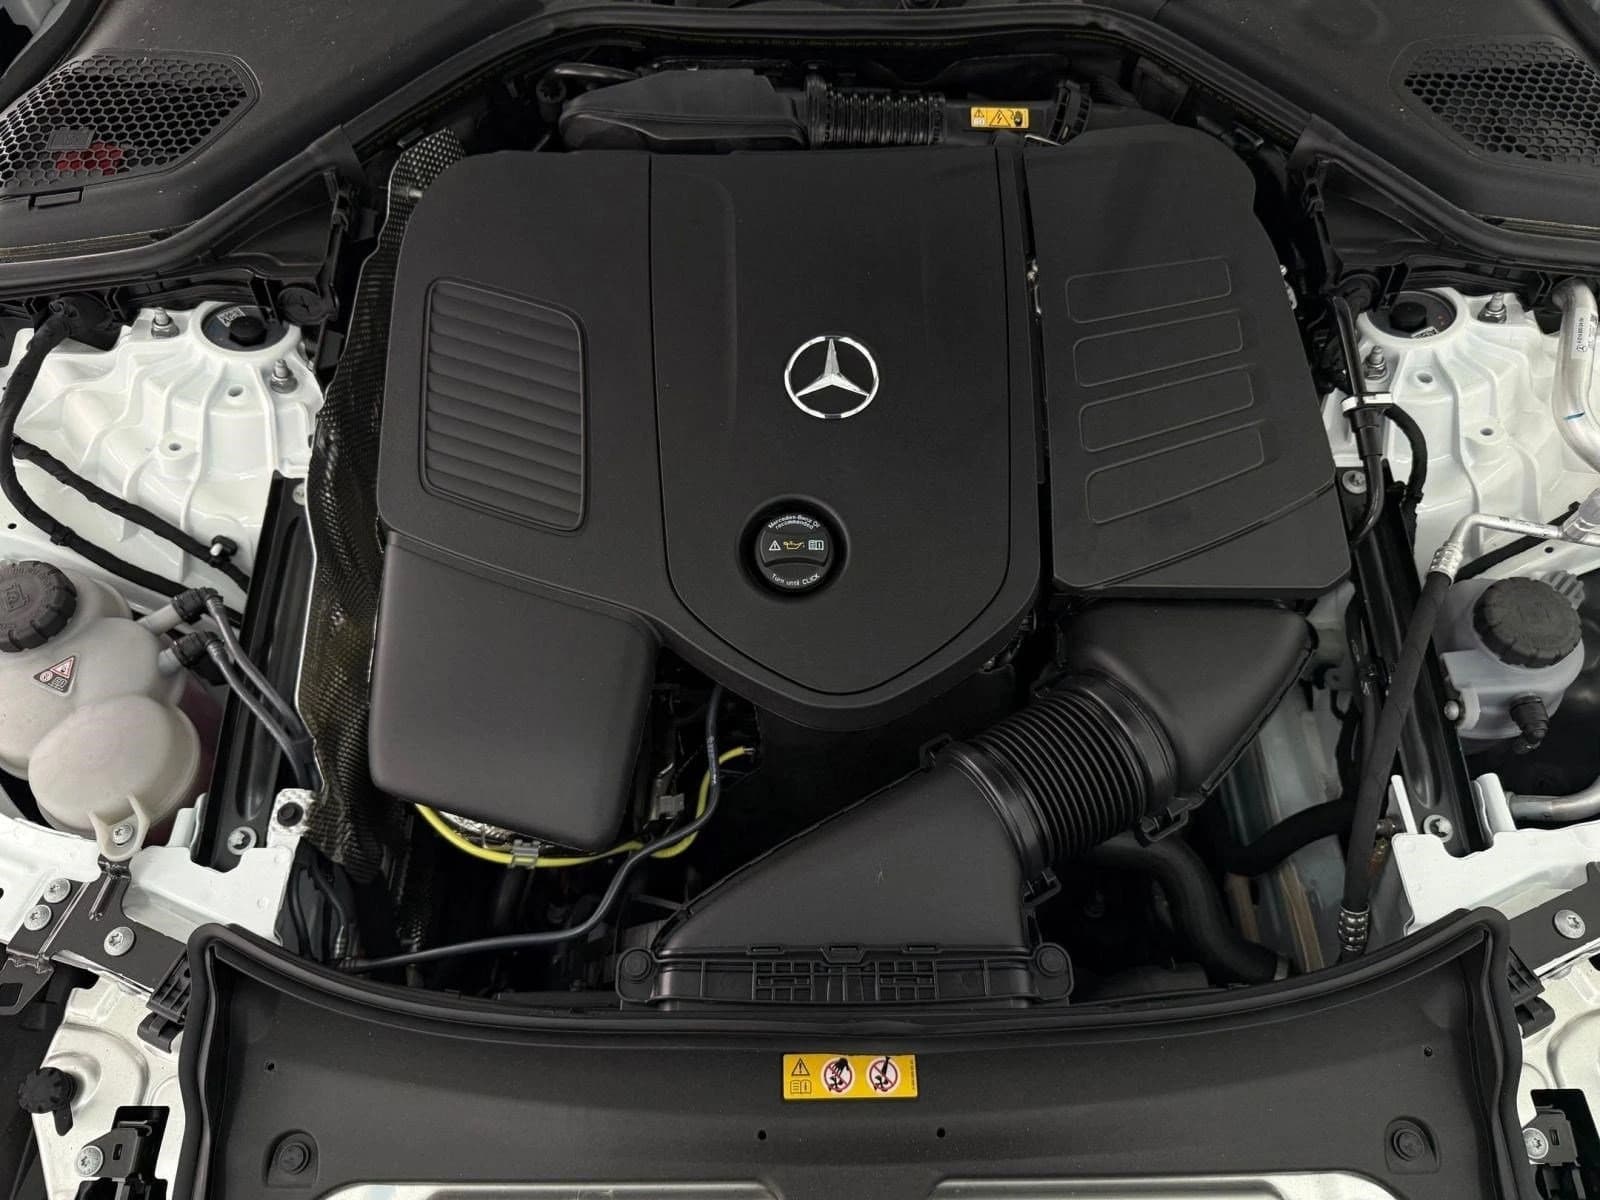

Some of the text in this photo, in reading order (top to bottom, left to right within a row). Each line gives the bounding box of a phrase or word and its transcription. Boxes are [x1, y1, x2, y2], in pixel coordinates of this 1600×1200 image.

[768, 514, 813, 529] Mercedes-Benz
[772, 573, 785, 584] Turn
[802, 573, 820, 585] CLICK
